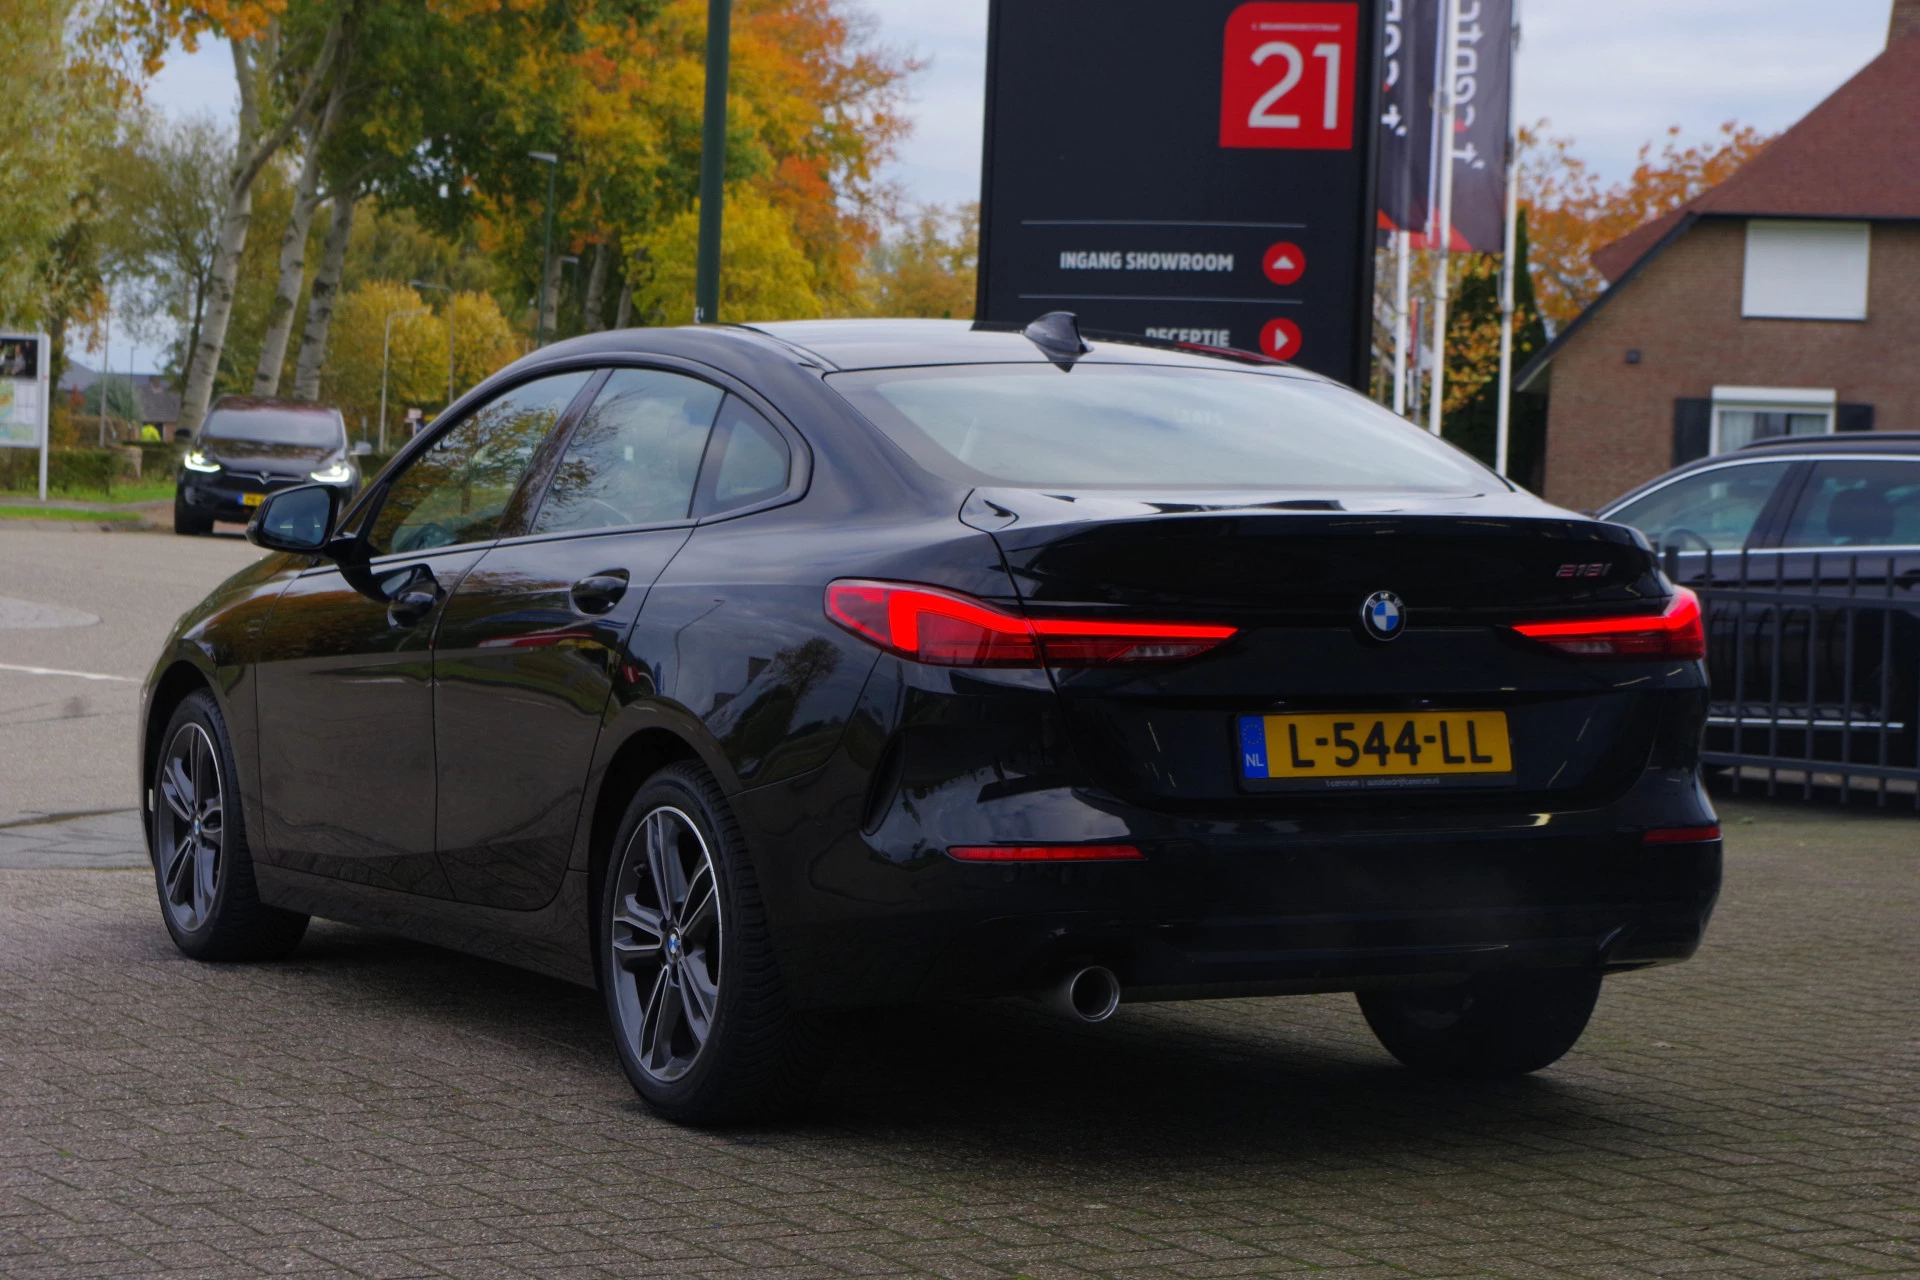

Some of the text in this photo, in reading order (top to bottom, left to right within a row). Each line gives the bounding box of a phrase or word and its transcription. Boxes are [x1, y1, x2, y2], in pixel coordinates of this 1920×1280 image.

[1247, 40, 1341, 130] 21
[1060, 252, 1234, 272] INGANG SHOWROOM
[1367, 592, 1403, 608] BMW
[1288, 720, 1493, 768] L-544-LL
[1245, 753, 1264, 767] NL
